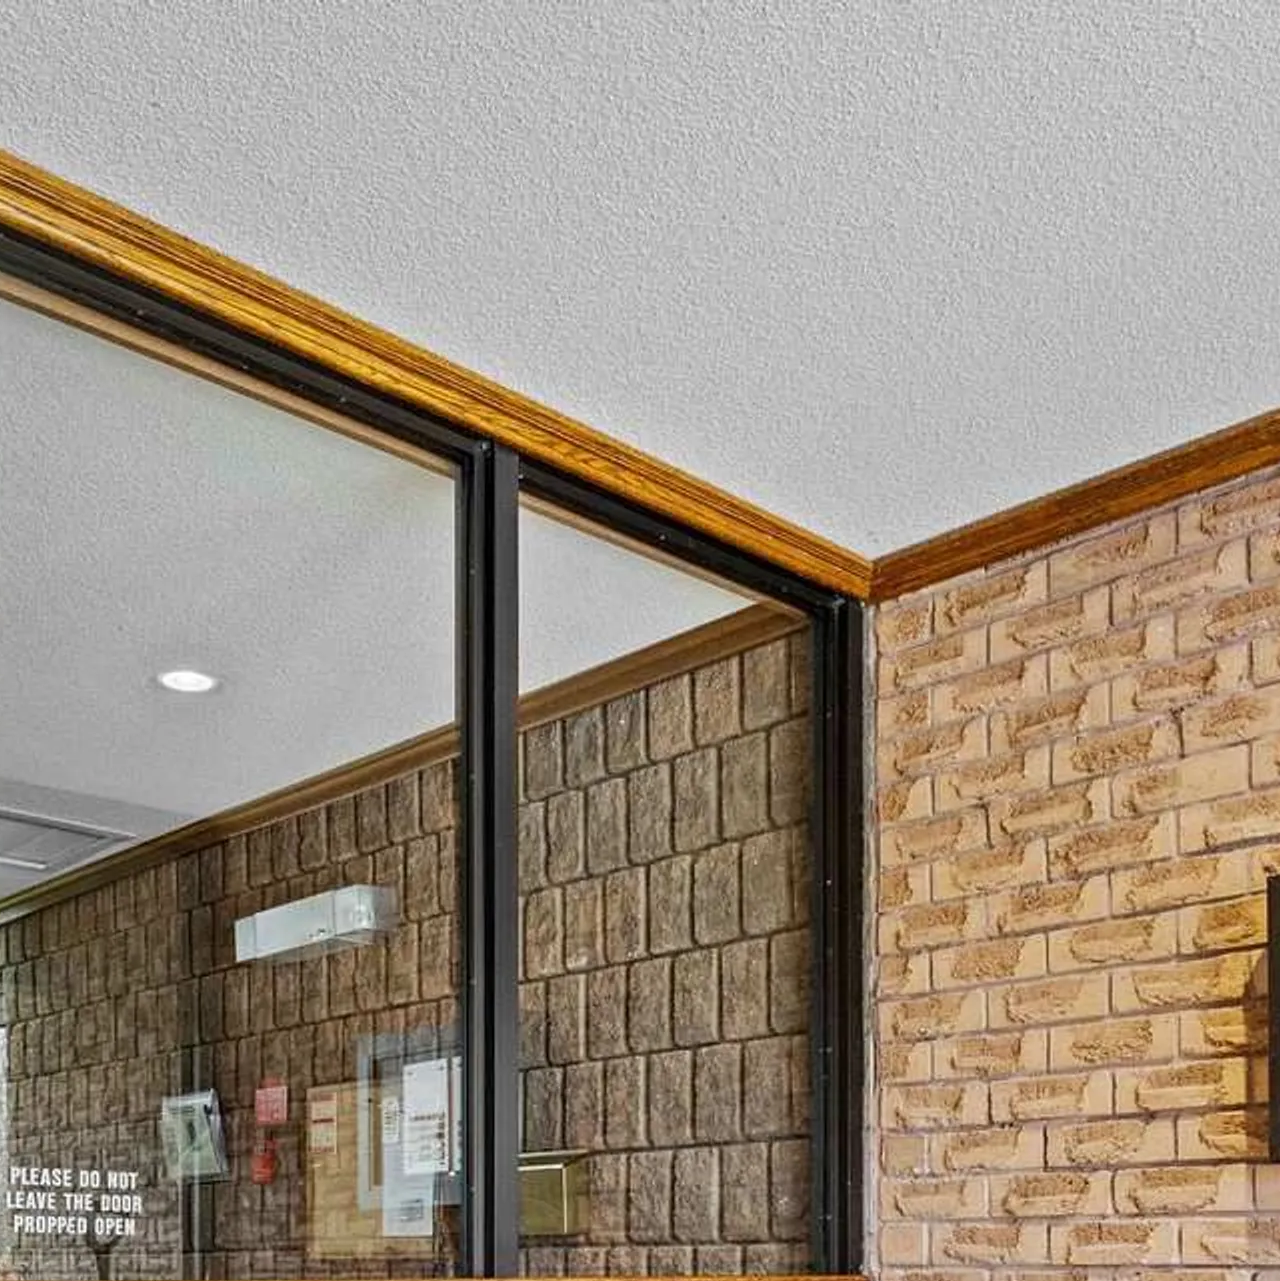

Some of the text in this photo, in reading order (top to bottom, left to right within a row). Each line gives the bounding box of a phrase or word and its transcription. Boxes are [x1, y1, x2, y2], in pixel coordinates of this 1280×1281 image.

[10, 1167, 139, 1190] PLEASE DO NOT
[6, 1191, 142, 1213] LEAVE THE DOOR
[13, 1214, 135, 1236] PROPPED OPEN
